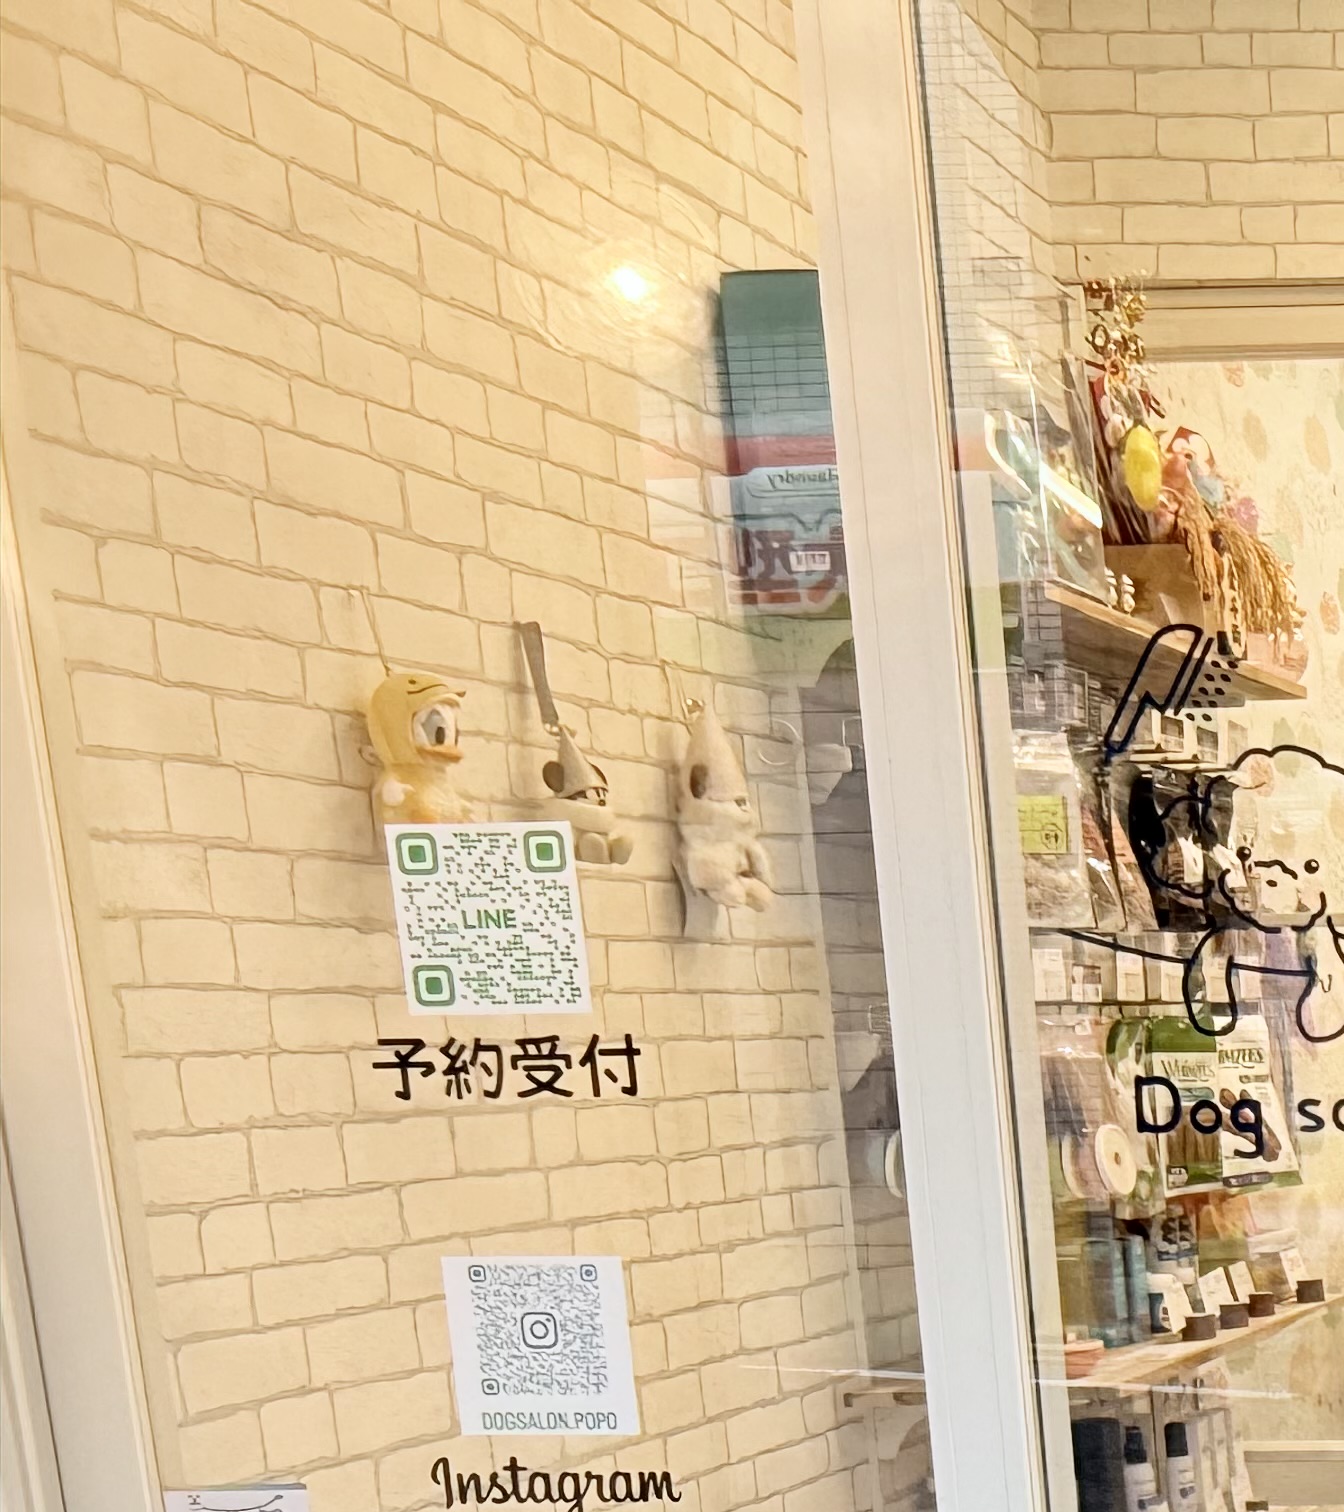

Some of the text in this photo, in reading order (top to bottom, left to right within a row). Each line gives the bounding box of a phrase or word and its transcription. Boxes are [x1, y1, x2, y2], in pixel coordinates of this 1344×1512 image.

[461, 906, 518, 932] LINE
[372, 1034, 642, 1100] 予約受付
[1135, 1075, 1265, 1158] Dog
